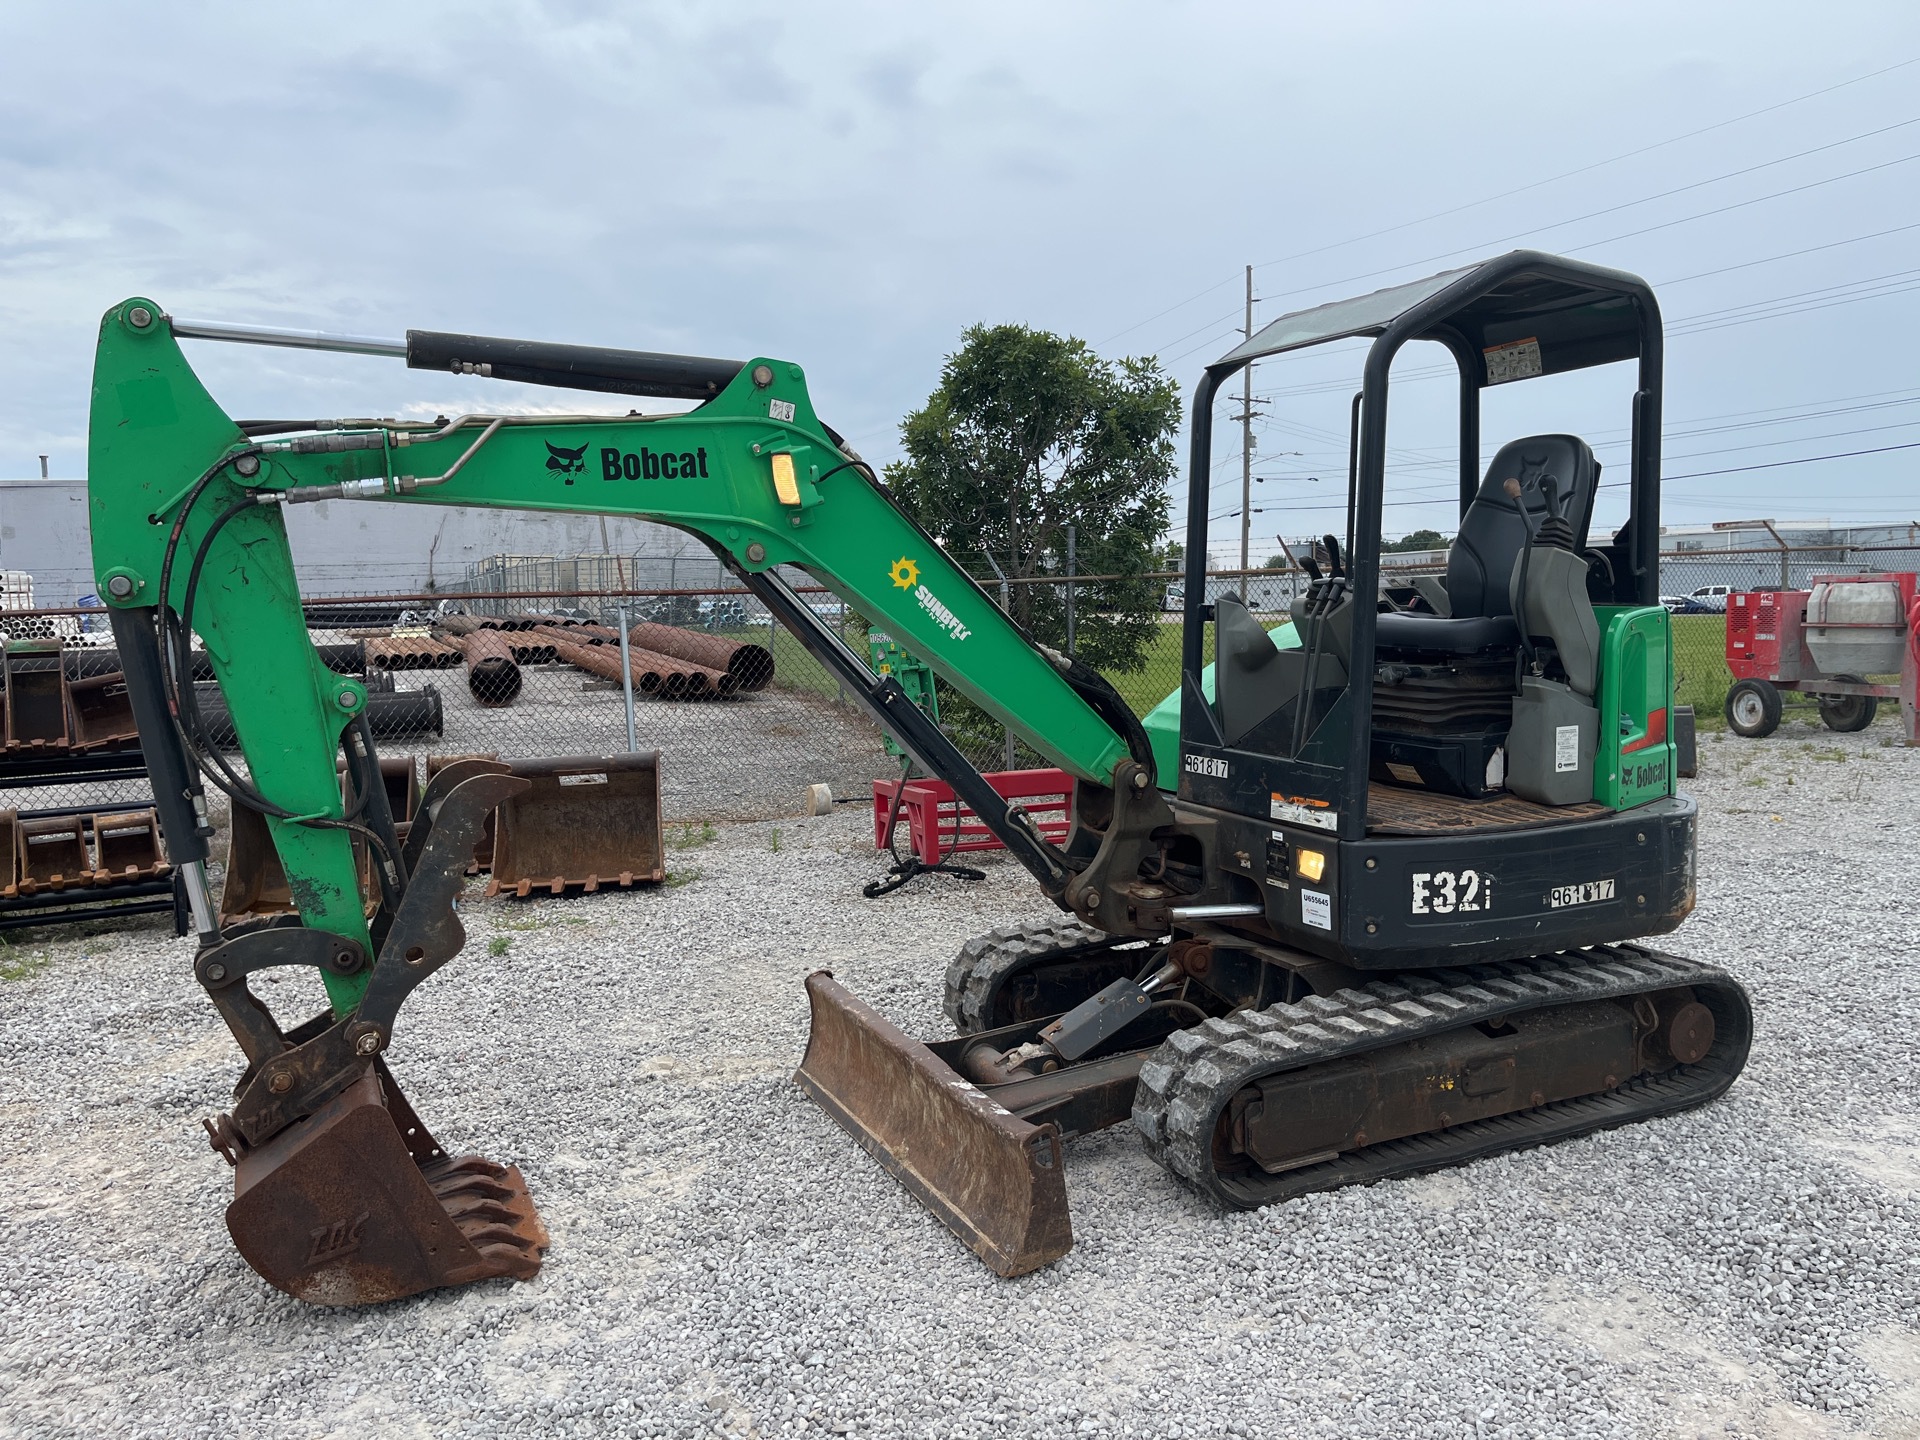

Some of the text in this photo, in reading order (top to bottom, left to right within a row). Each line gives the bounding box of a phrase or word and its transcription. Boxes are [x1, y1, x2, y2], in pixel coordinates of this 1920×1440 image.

[600, 446, 710, 482] Bobcat
[917, 601, 957, 640] RNTAS
[1185, 755, 1228, 778] 961817
[1636, 757, 1666, 789] Bobcat
[1303, 894, 1329, 907] U655645
